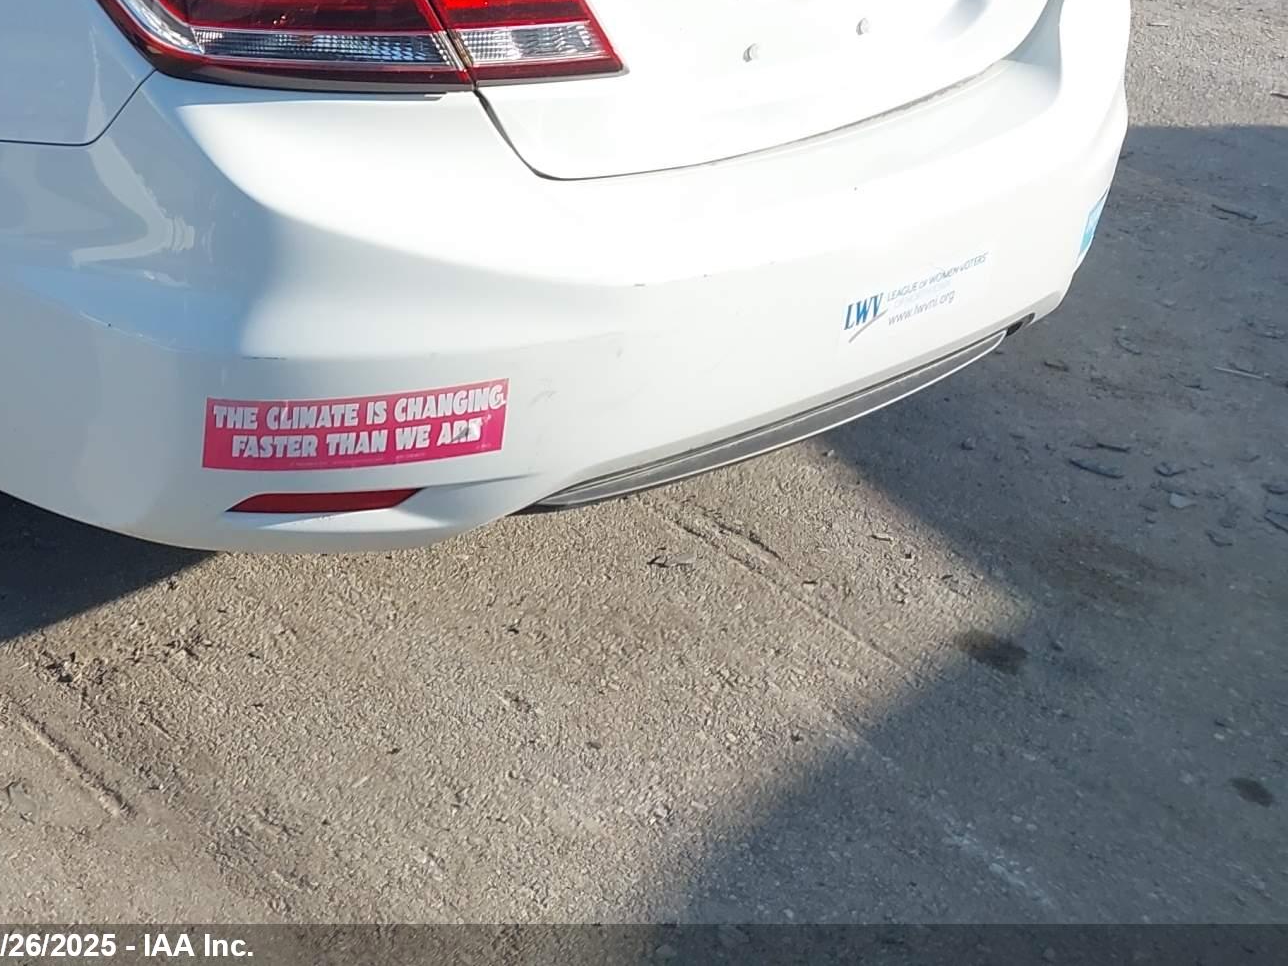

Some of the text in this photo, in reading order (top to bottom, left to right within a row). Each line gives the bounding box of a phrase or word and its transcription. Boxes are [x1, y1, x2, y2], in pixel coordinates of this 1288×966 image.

[887, 281, 918, 302] LEAGUE
[928, 266, 959, 285] WOMEN
[843, 292, 884, 331] LWV
[213, 385, 507, 430] THE CLIMATE IS CHANGING
[231, 435, 318, 459] FASTER
[326, 430, 387, 455] THAN
[395, 423, 431, 450] WE
